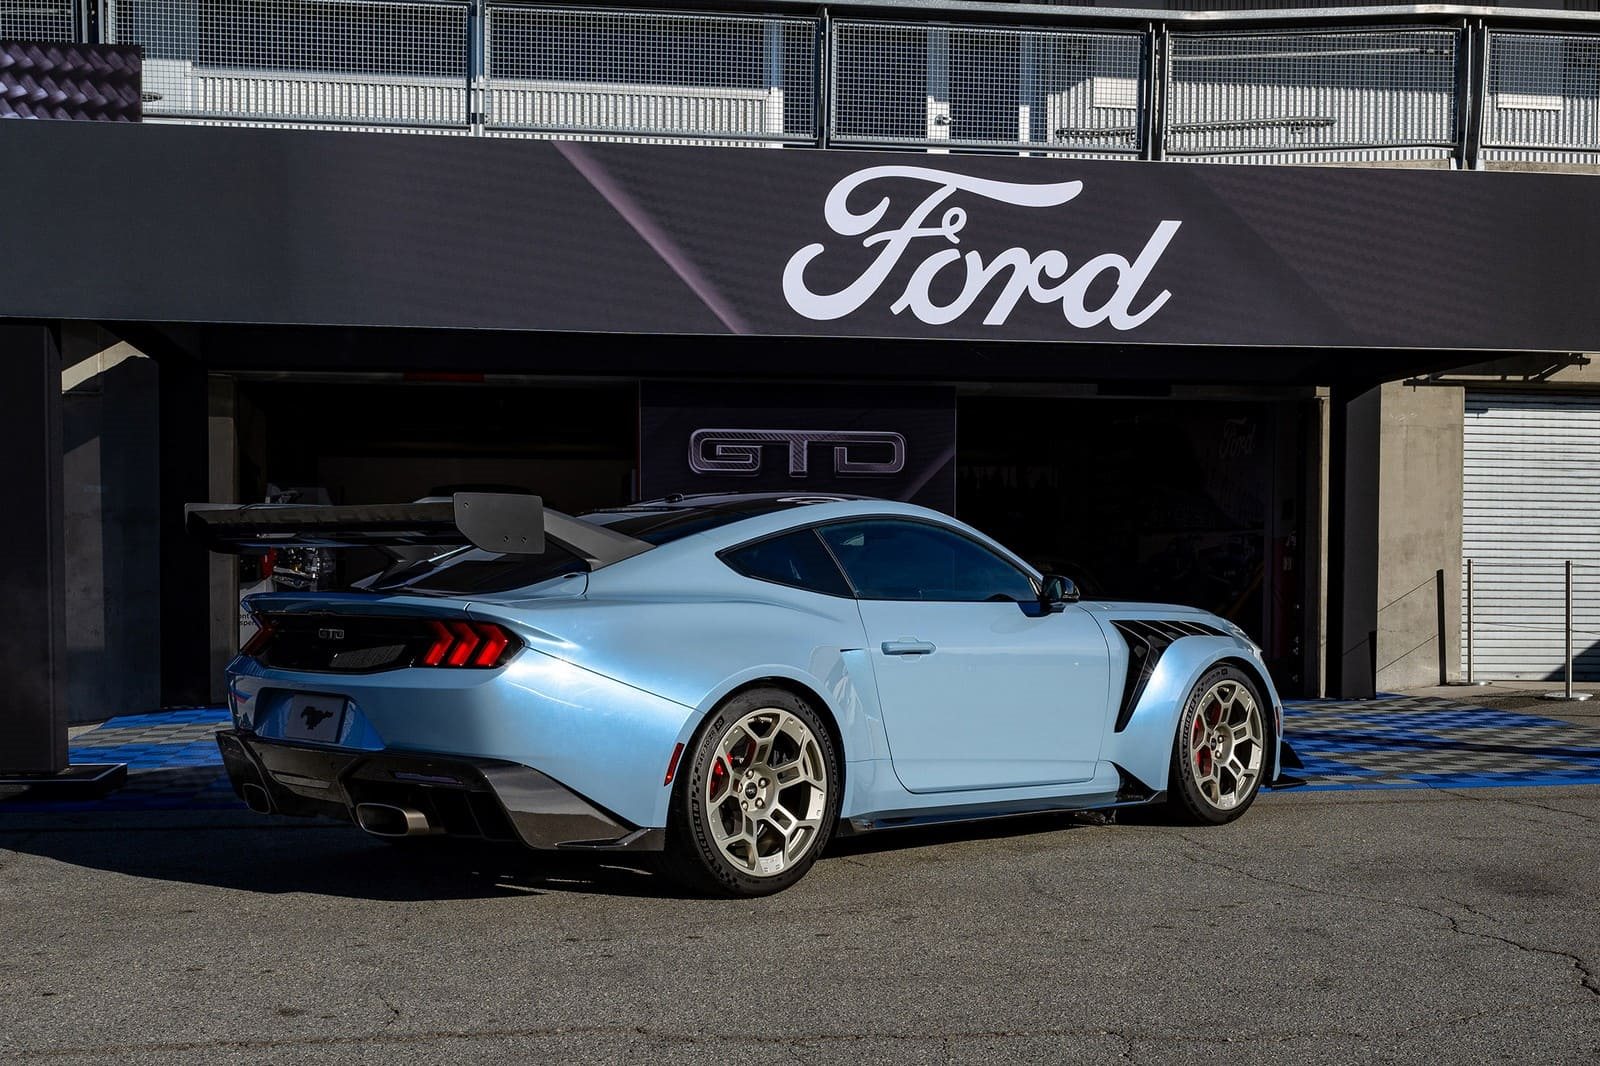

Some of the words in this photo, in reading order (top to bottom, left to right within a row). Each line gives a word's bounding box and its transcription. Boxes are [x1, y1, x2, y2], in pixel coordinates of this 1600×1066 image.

[782, 165, 1183, 331] Ford
[689, 428, 906, 477] GTD
[1218, 416, 1256, 457] Ford
[319, 628, 344, 640] GTD
[692, 801, 715, 862] MICHELIN
